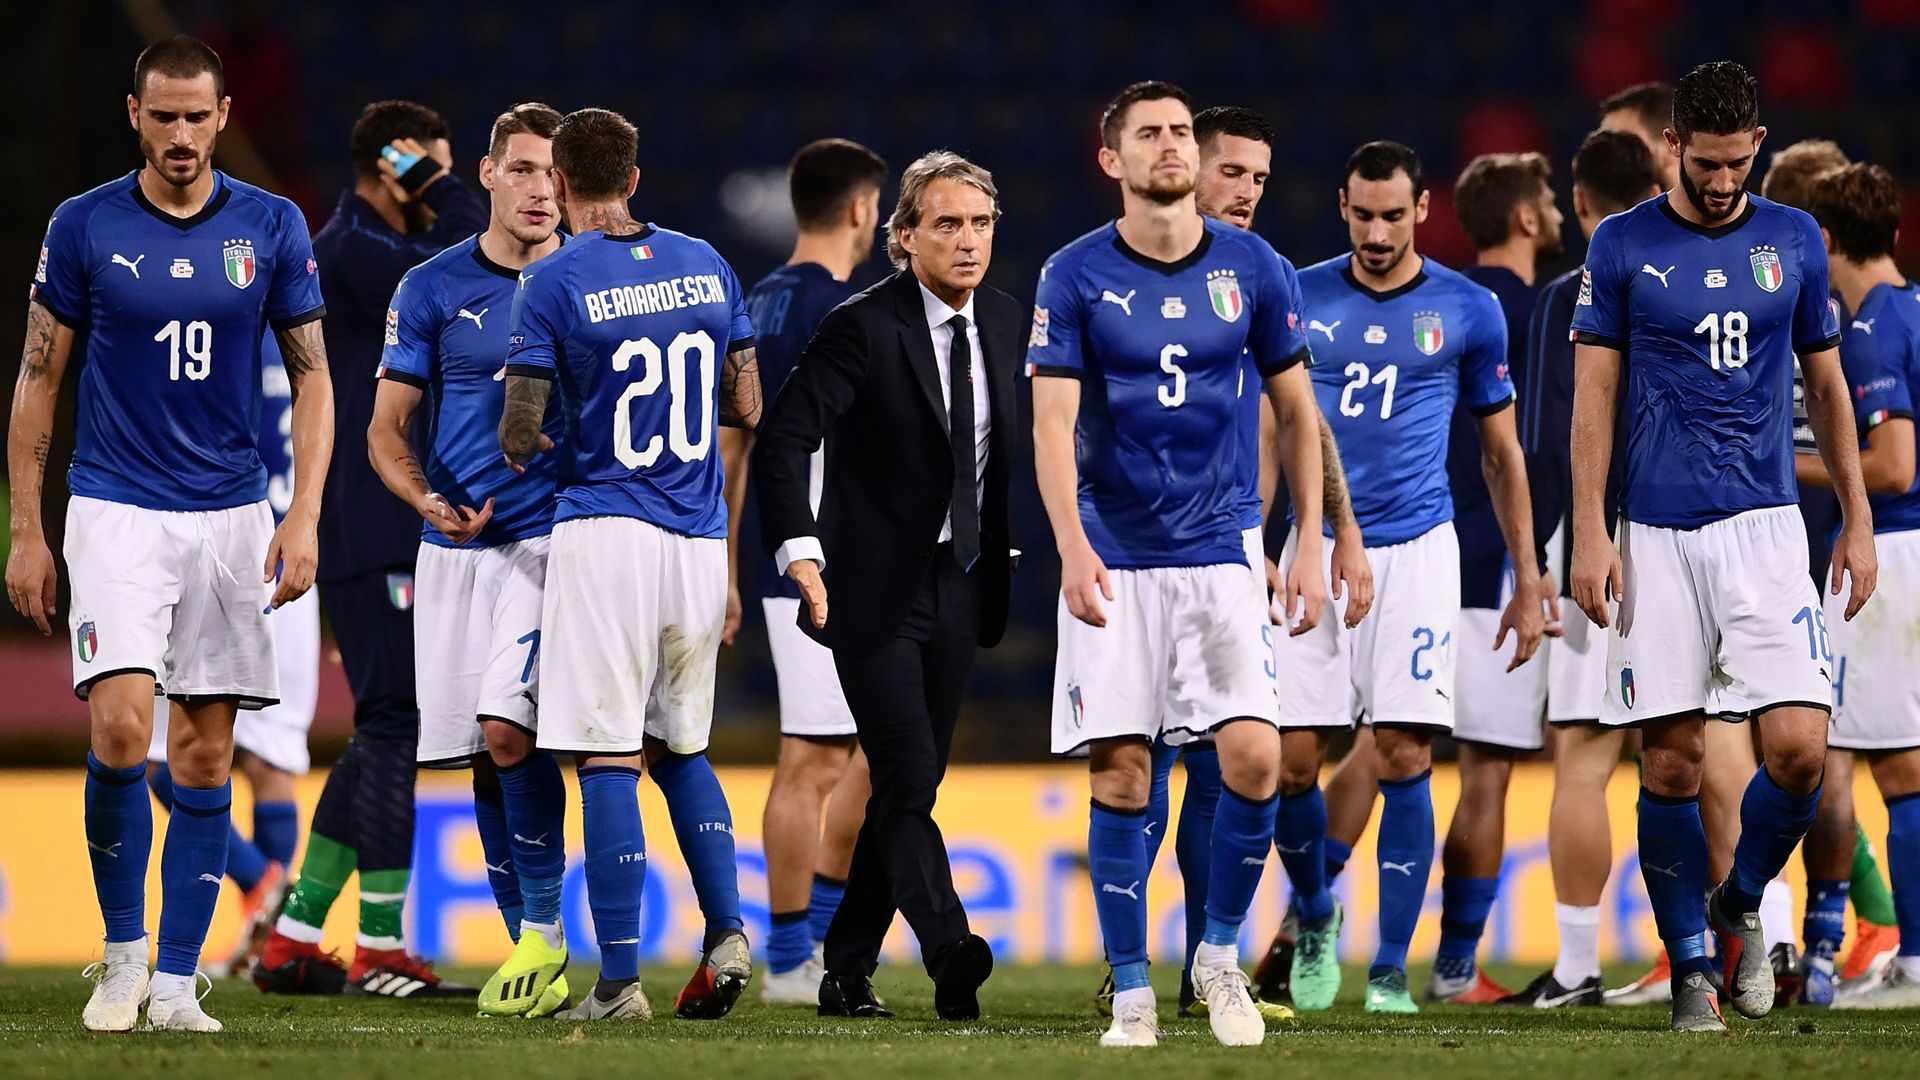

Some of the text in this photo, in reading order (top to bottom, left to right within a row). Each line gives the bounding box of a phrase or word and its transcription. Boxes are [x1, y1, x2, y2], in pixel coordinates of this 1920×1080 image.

[585, 274, 726, 324] BERNARDESCHI
[154, 320, 213, 381] 19
[1693, 310, 1749, 370] 18
[612, 330, 715, 470] 20
[1157, 343, 1189, 408] 5
[1339, 361, 1398, 420] 21
